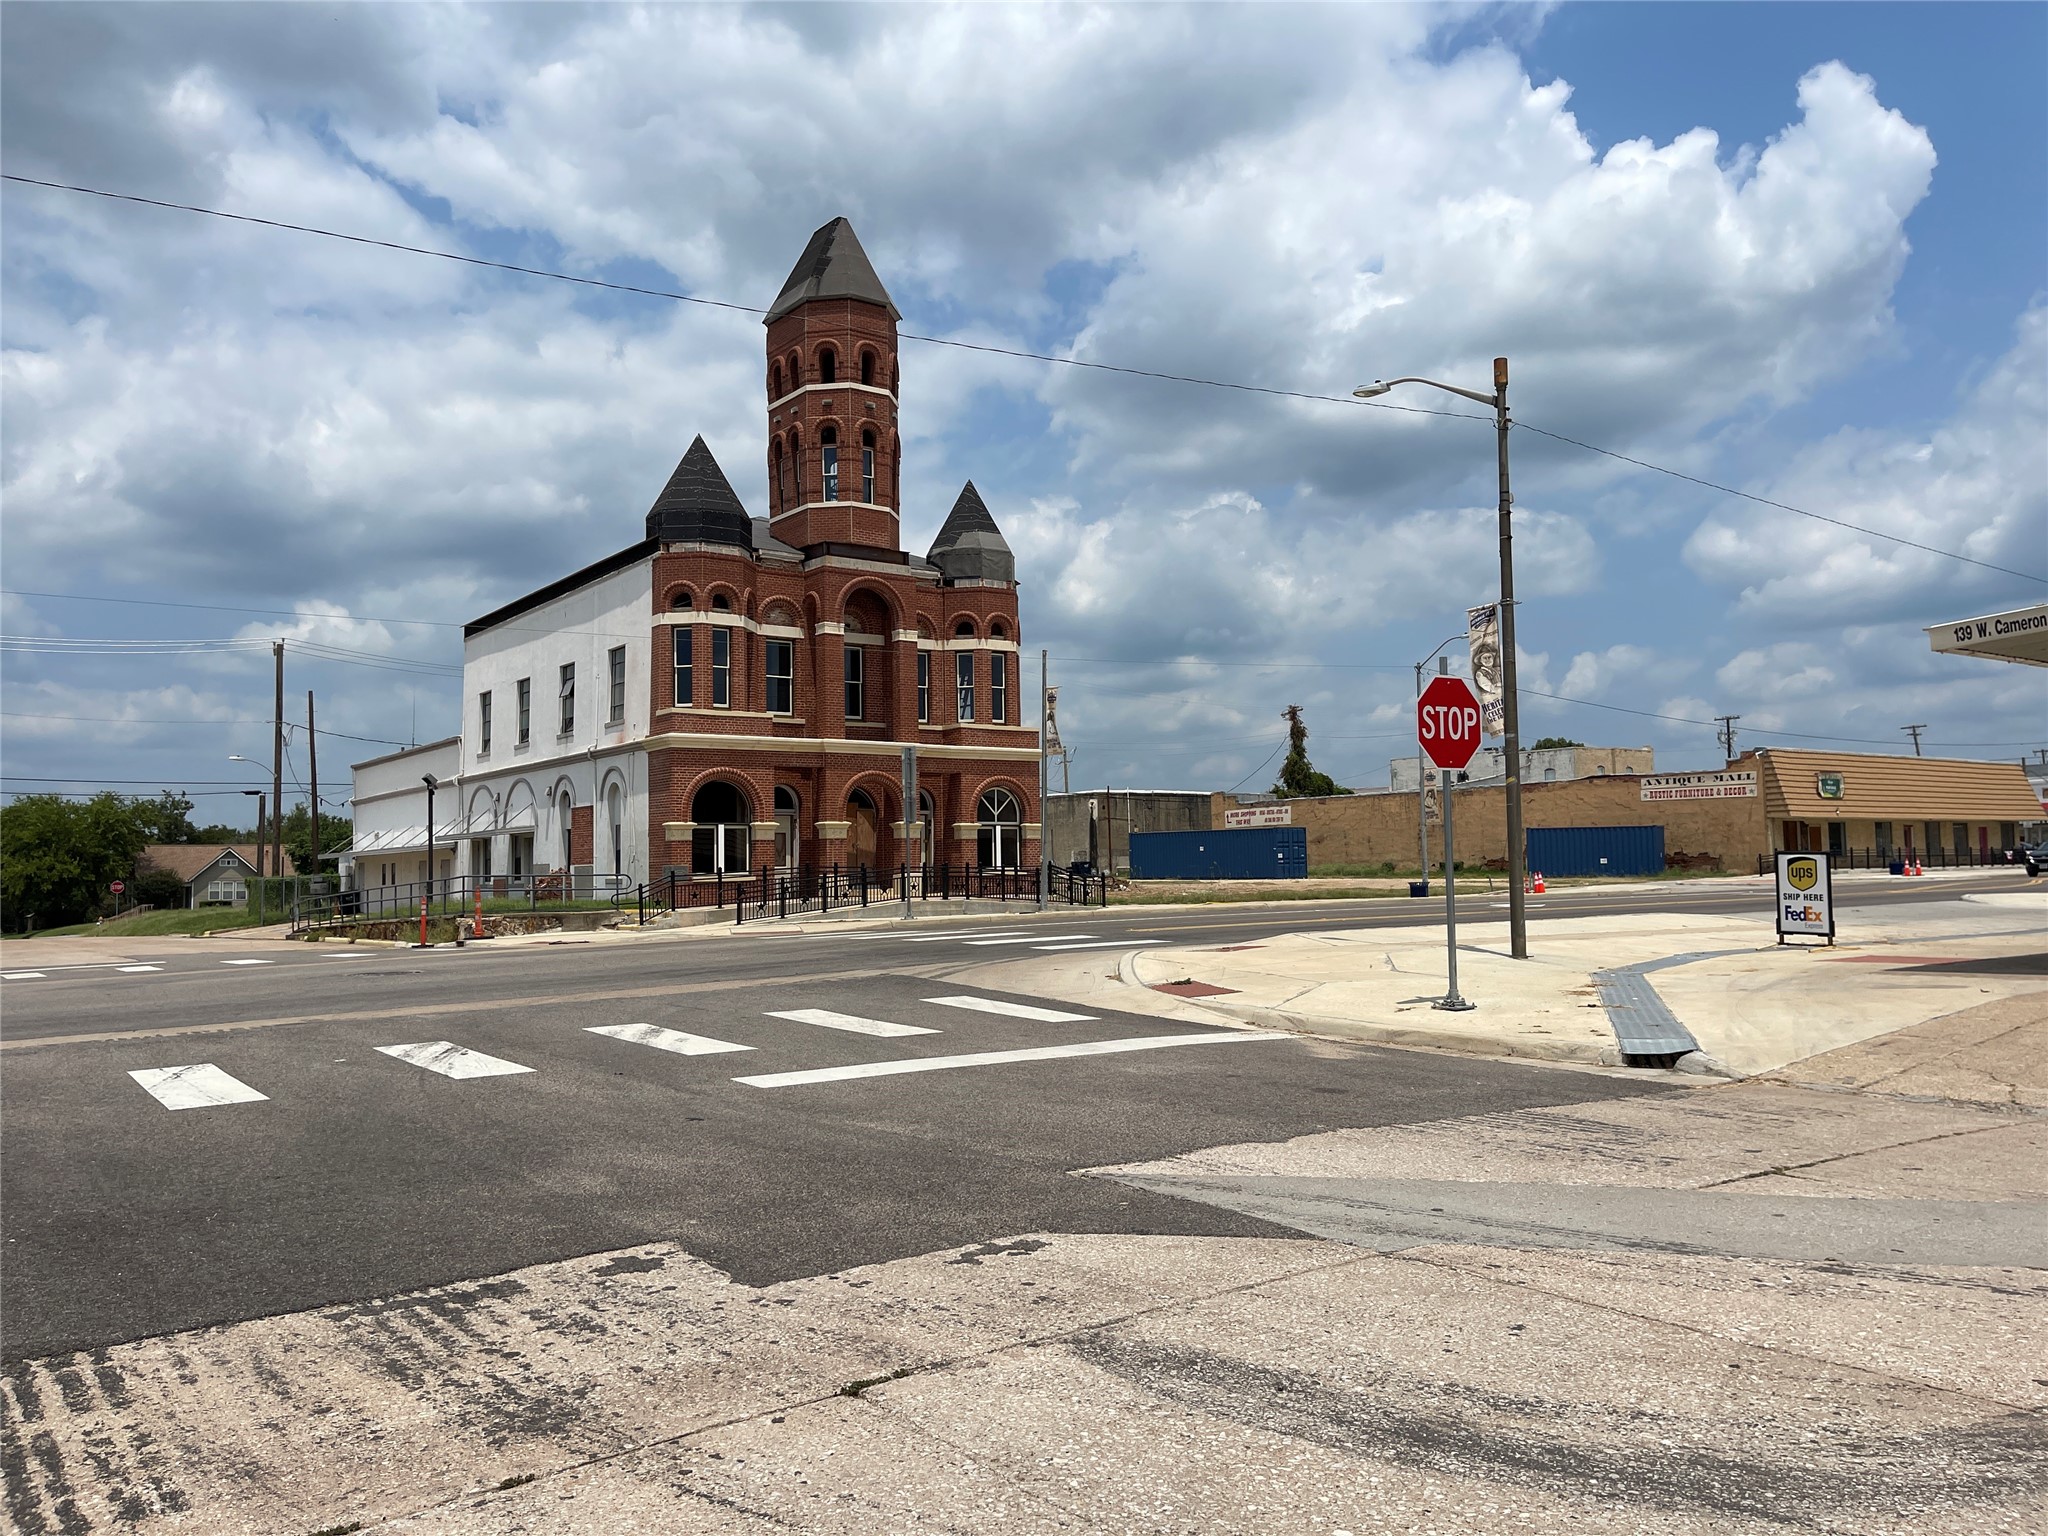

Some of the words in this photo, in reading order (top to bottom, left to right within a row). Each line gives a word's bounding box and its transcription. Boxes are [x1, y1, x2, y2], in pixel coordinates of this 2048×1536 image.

[1954, 625, 1973, 642] 139
[1976, 622, 1992, 638] W.
[1995, 615, 2047, 635] Cameron
[1421, 705, 1477, 740] STOP
[1643, 775, 1706, 787] ANTIQUE
[1713, 773, 1755, 783] MALL
[1649, 789, 1673, 799] RUSTIC
[1675, 788, 1714, 799] FURNITURE
[1716, 787, 1722, 796] &
[1724, 786, 1747, 796] DECOR
[1791, 867, 1814, 881] ups
[1783, 892, 1801, 901] SHIP
[1803, 893, 1824, 901] HERE
[1784, 904, 1823, 922] FedEx
